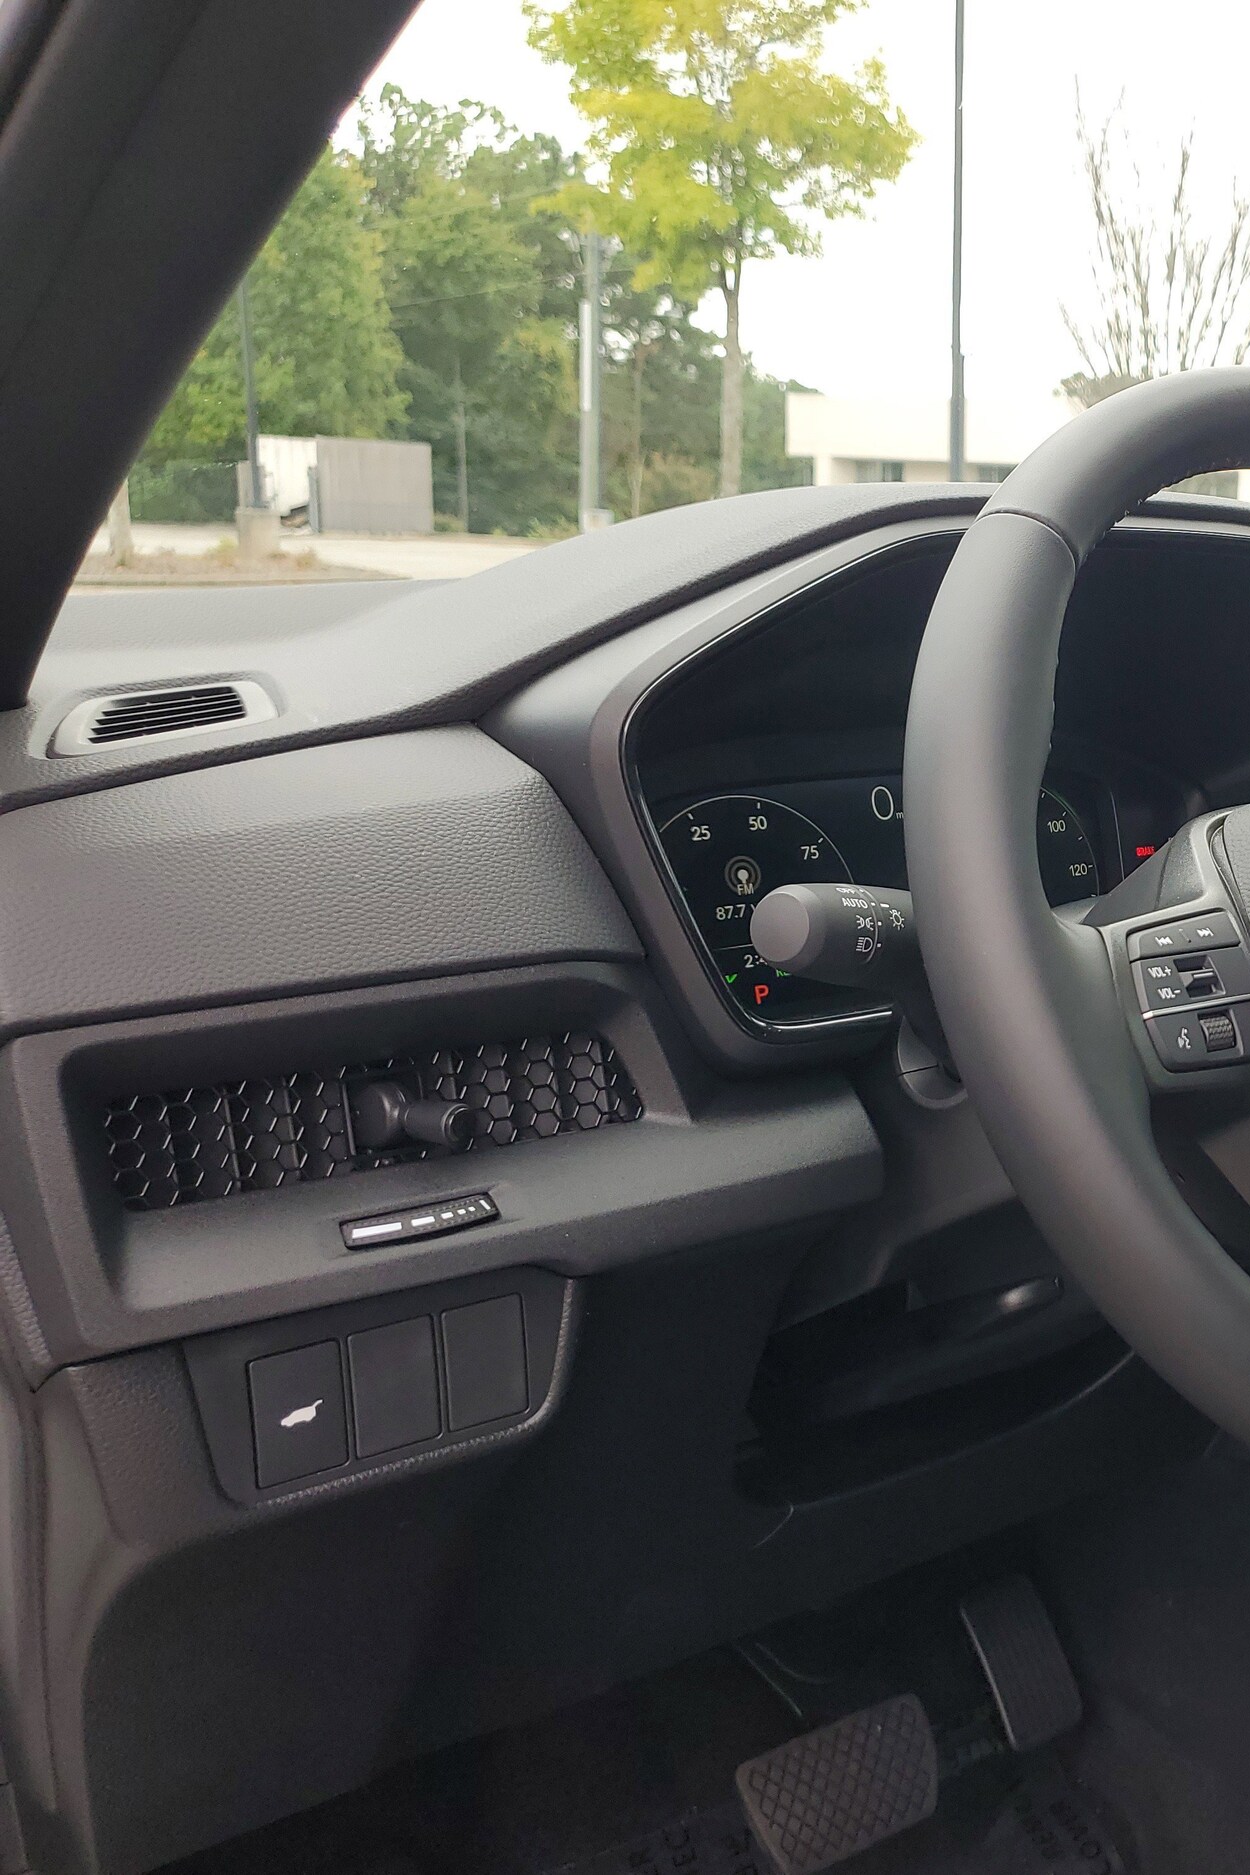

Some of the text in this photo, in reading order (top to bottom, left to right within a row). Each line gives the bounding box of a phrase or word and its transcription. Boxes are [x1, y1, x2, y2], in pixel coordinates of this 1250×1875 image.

[748, 815, 768, 831] 50
[1047, 819, 1066, 833] 100
[690, 825, 711, 842] 25
[800, 845, 819, 861] 75
[1069, 863, 1088, 877] 120
[737, 883, 754, 896] FM
[841, 897, 868, 909] AUTO
[716, 903, 746, 921] 87.7
[1147, 965, 1172, 979] VOL+
[754, 984, 769, 1004] P
[1157, 987, 1181, 1000] VOL-
